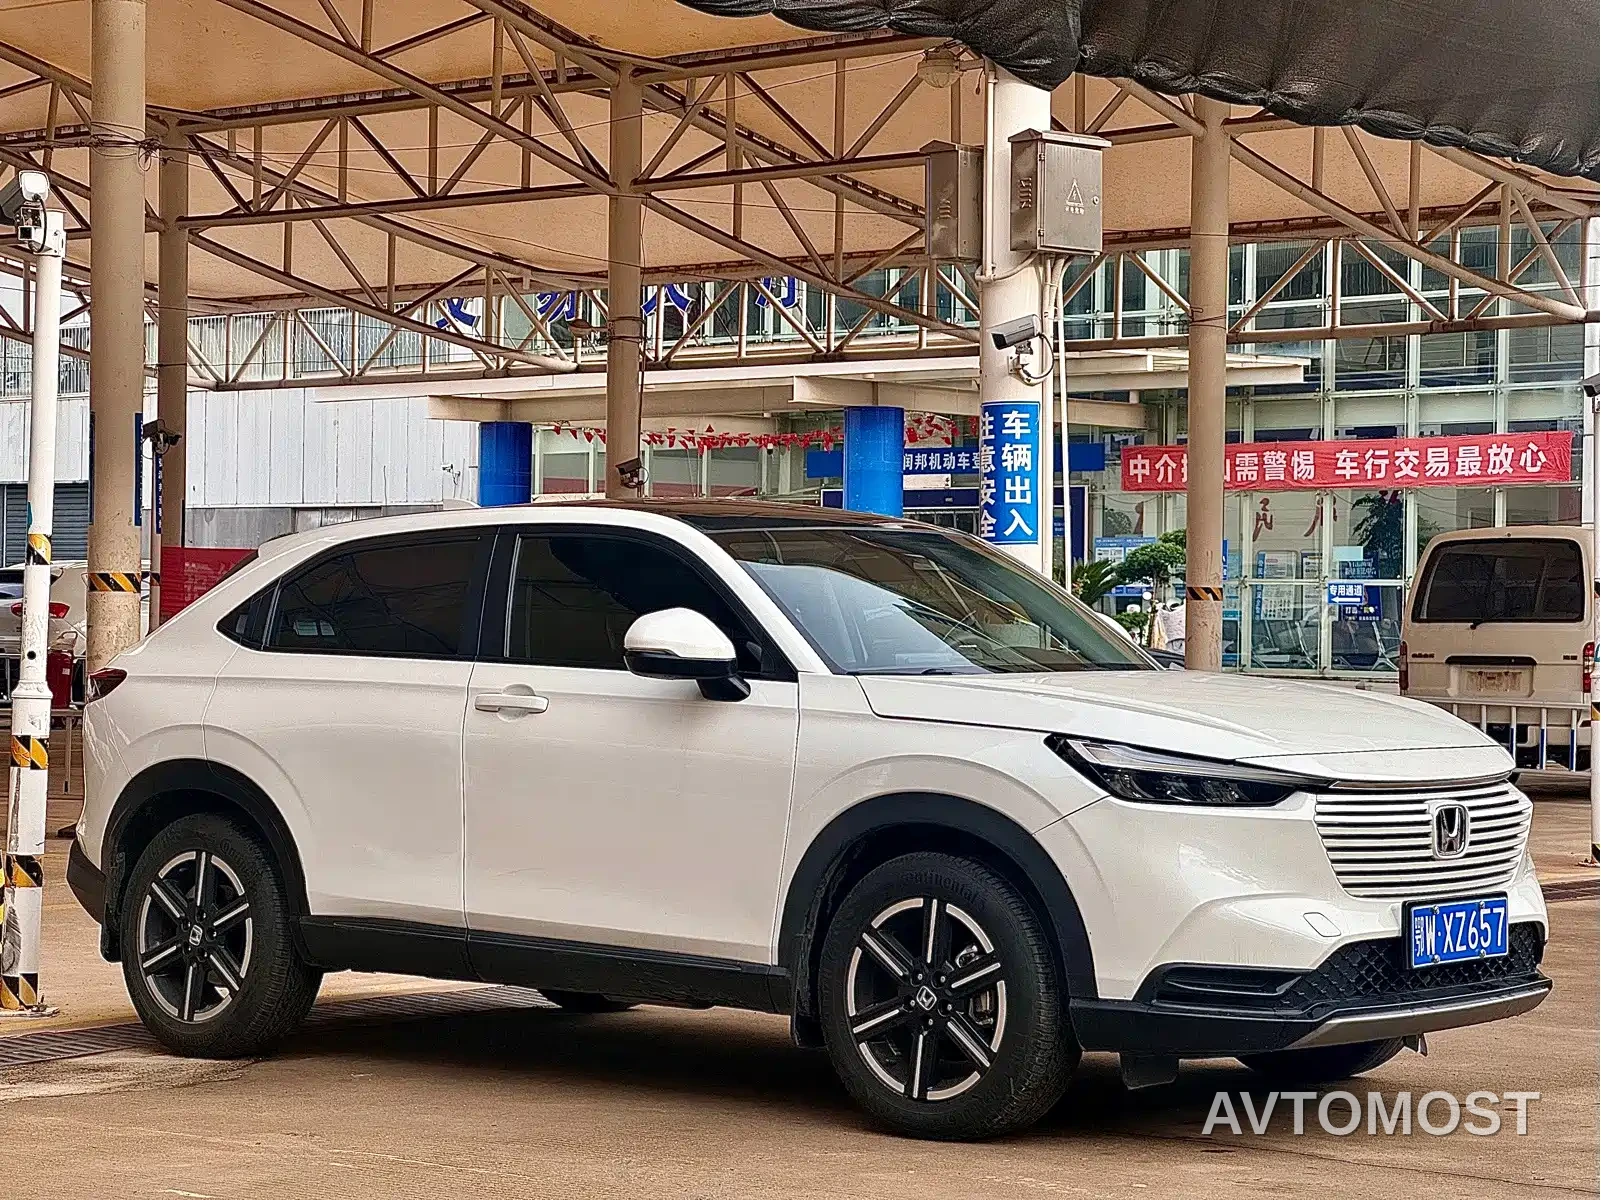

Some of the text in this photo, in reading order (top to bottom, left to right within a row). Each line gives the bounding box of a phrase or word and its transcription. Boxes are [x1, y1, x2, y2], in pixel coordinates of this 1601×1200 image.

[1001, 410, 1034, 537] 车辆出入
[1129, 441, 1547, 484] 中介需警惕 车行交易最放心
[1329, 584, 1363, 597] 专用通道
